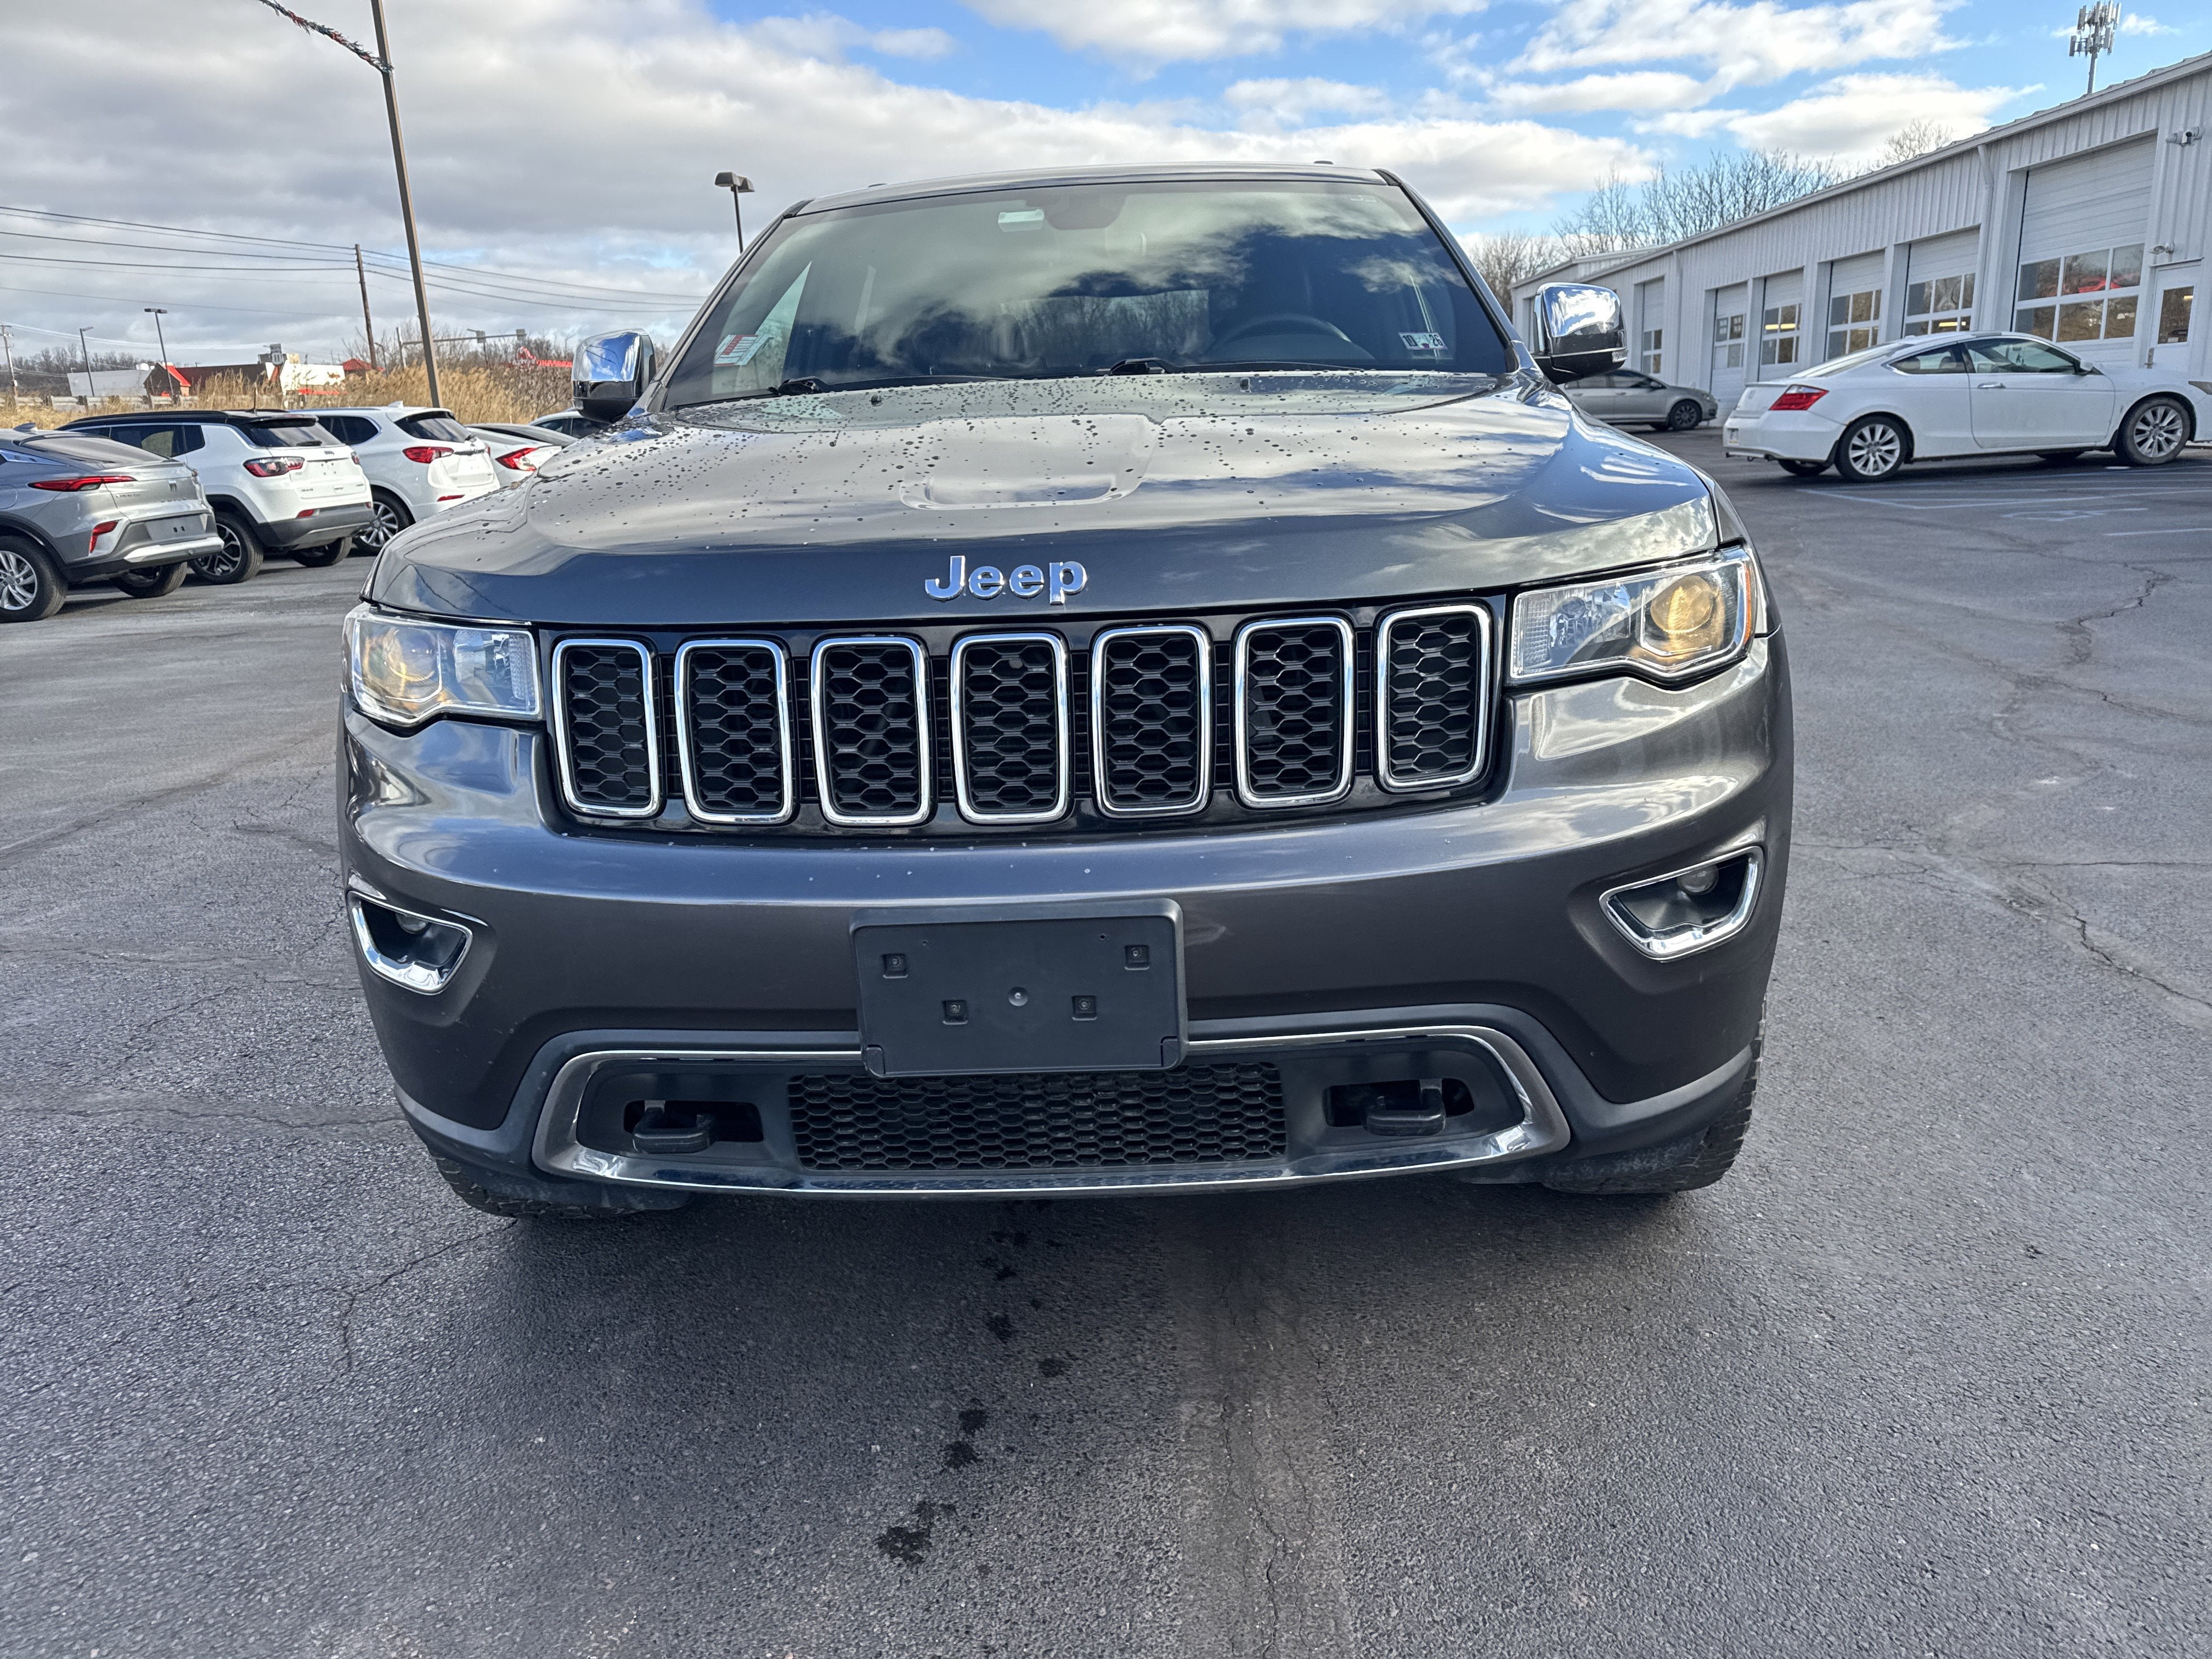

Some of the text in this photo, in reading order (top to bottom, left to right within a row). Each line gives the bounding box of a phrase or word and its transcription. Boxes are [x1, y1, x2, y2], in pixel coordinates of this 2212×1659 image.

[1402, 334, 1443, 347] 10 26
[924, 555, 1087, 605] Jeep
